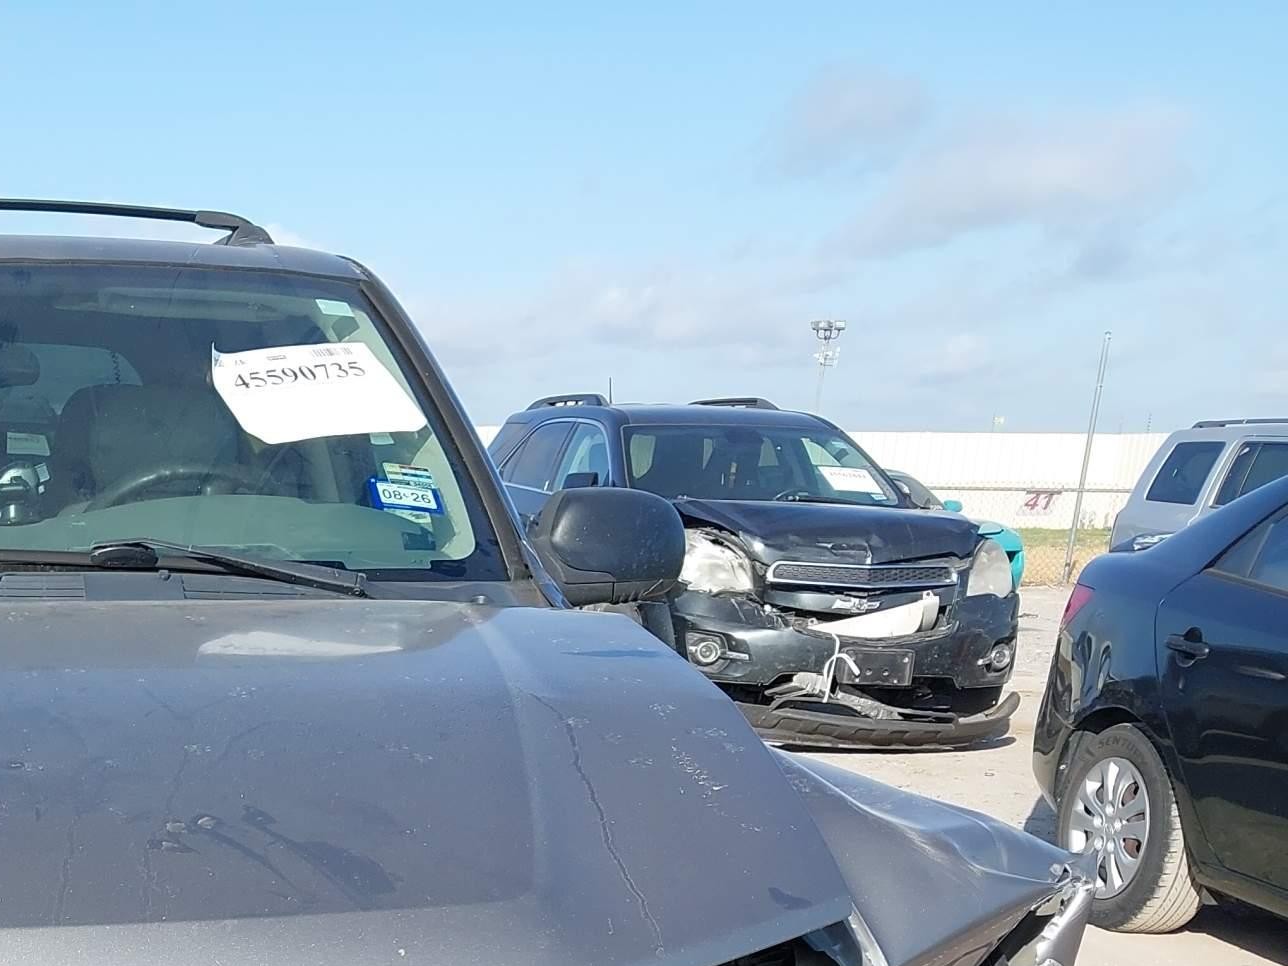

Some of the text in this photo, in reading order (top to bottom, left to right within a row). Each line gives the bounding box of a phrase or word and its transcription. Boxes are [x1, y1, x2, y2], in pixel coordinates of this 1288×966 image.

[234, 361, 366, 389] 45590735
[382, 488, 432, 504] 08 26
